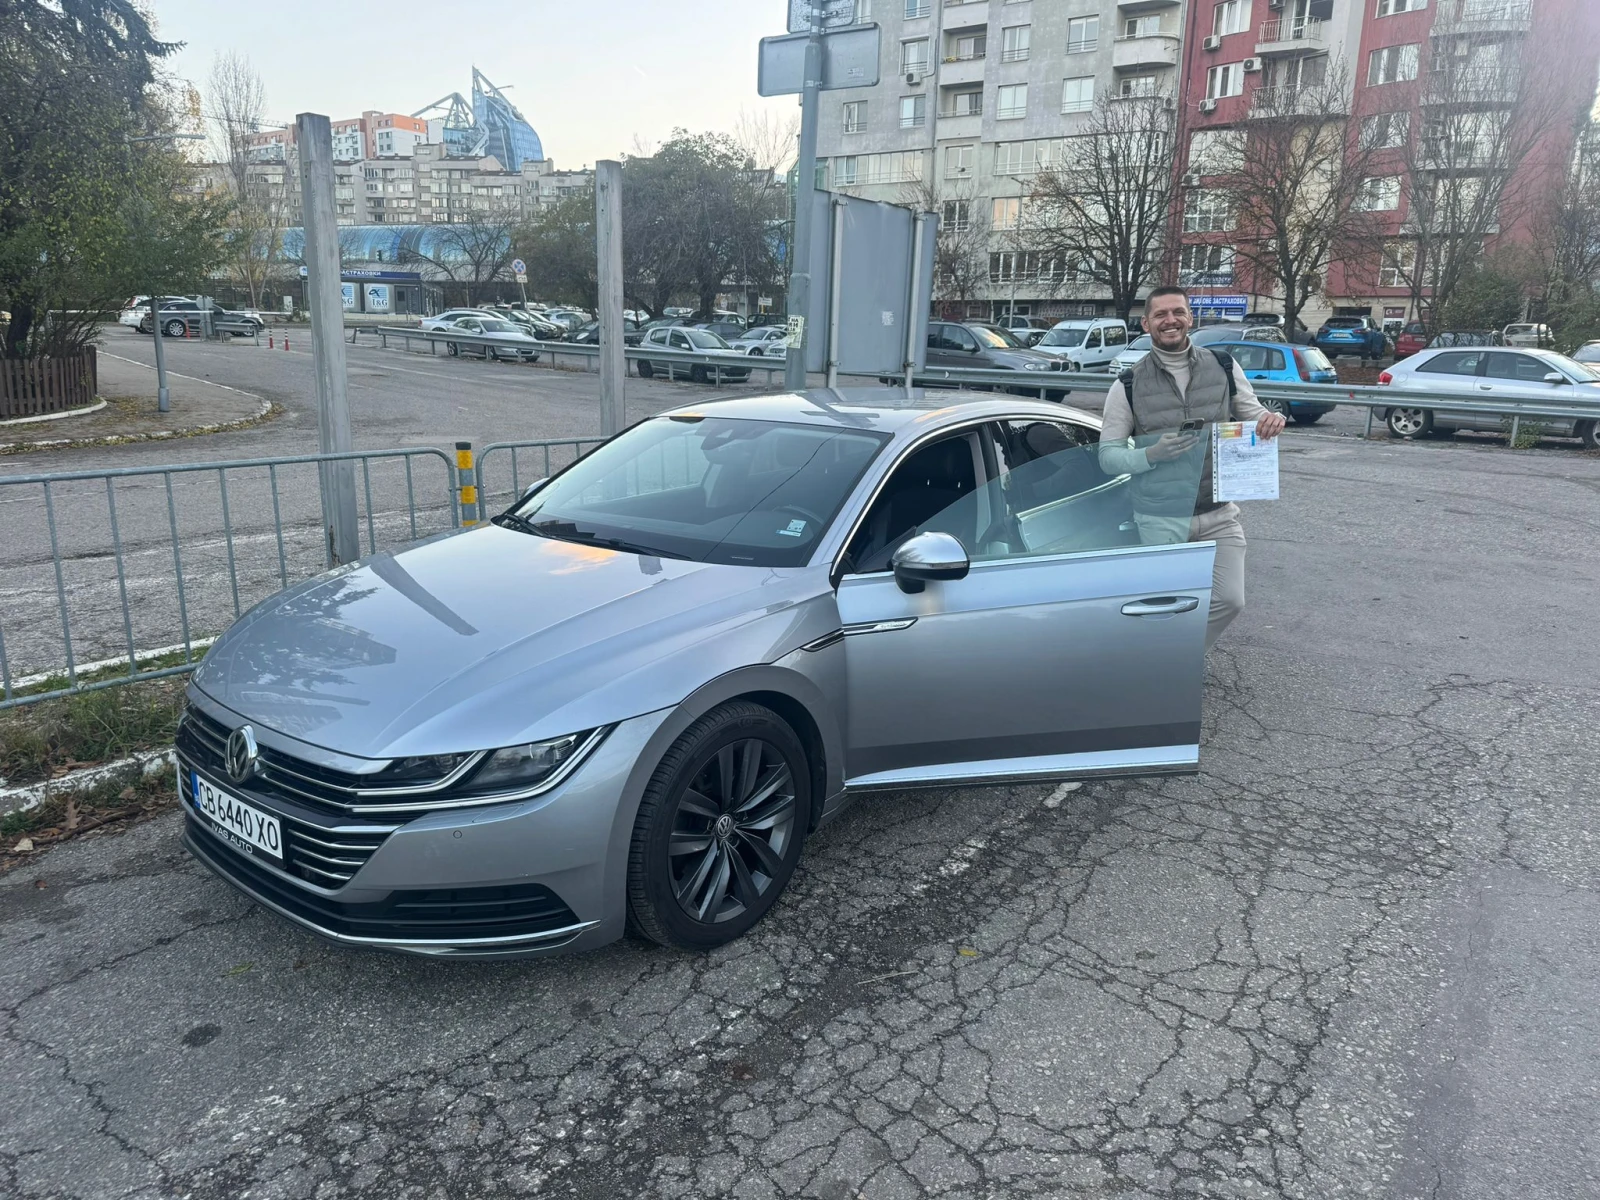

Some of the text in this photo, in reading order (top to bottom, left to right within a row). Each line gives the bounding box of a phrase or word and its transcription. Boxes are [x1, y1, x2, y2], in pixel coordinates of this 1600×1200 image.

[199, 781, 278, 851] CB 6440 XO
[230, 835, 253, 854] AUTO
